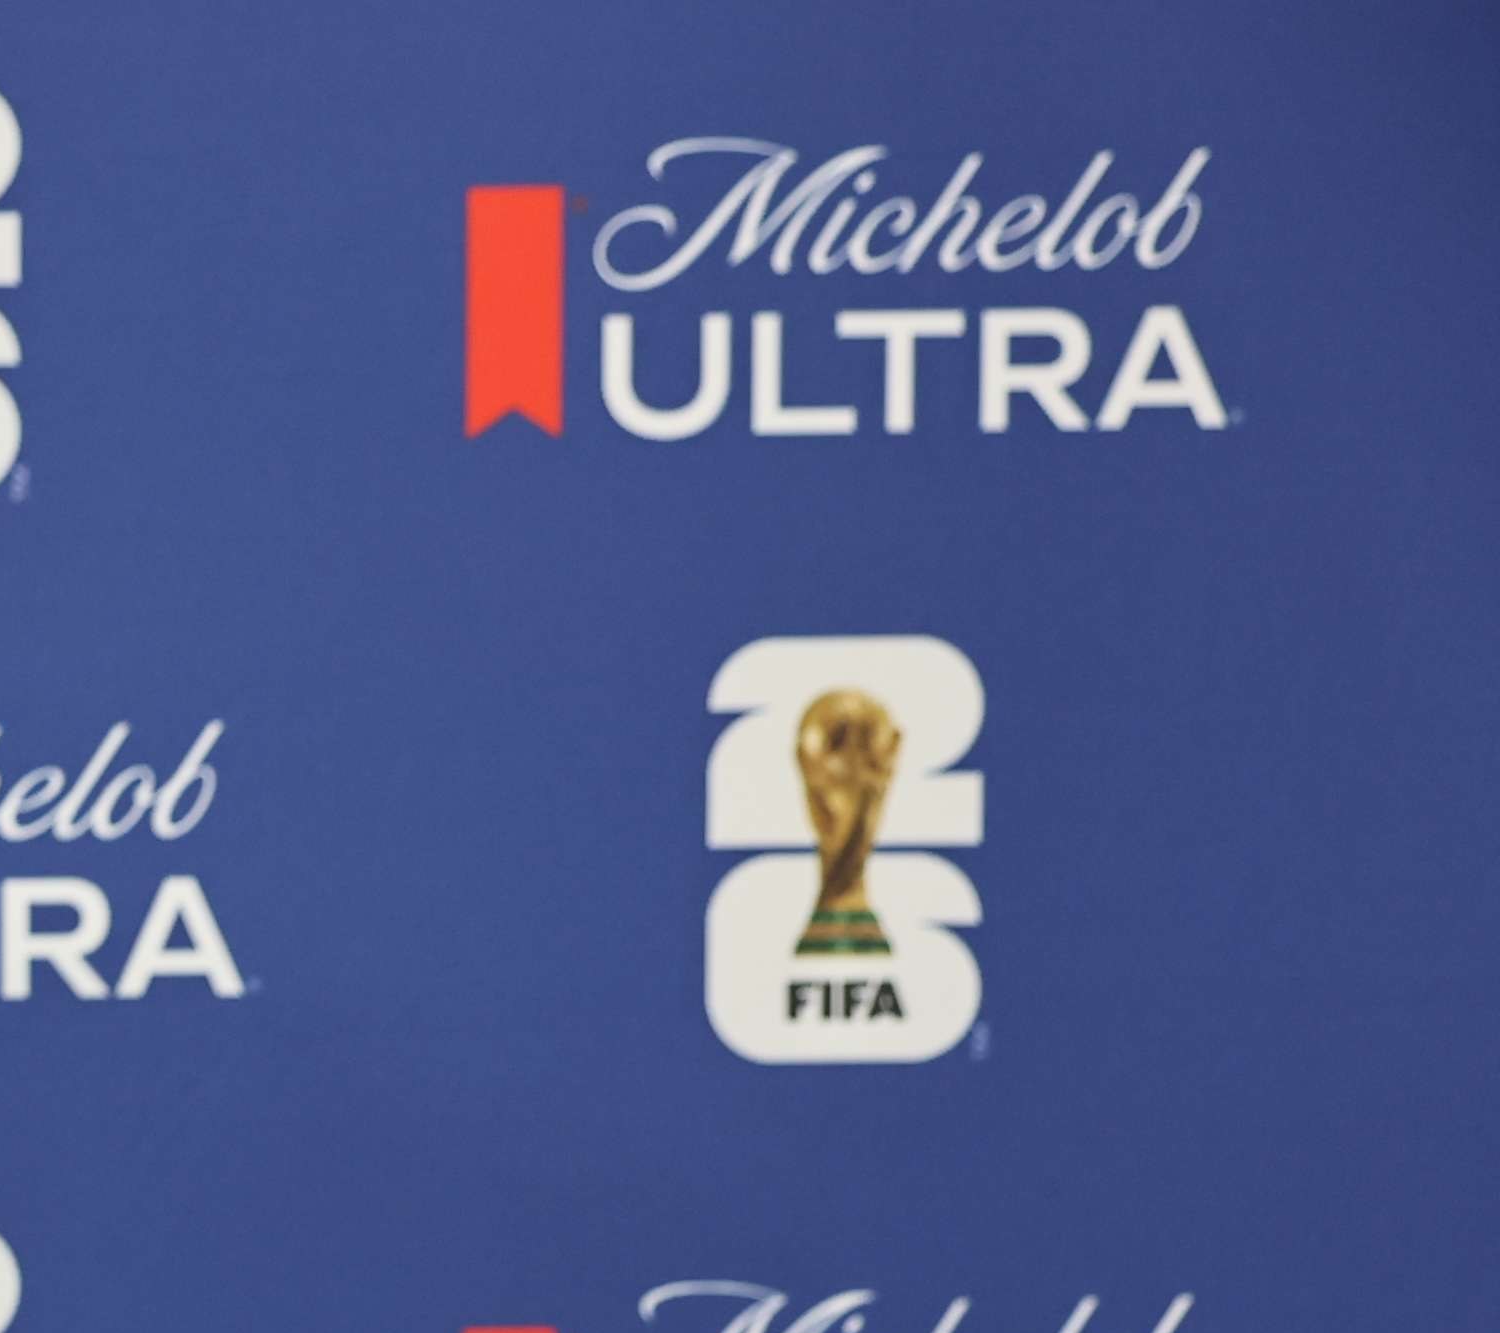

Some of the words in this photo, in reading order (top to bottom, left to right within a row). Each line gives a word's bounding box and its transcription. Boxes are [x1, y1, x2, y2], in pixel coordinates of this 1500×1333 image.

[593, 138, 1208, 291] Michelob
[602, 307, 1226, 440] ULTRA
[787, 981, 904, 1020] FIFA
